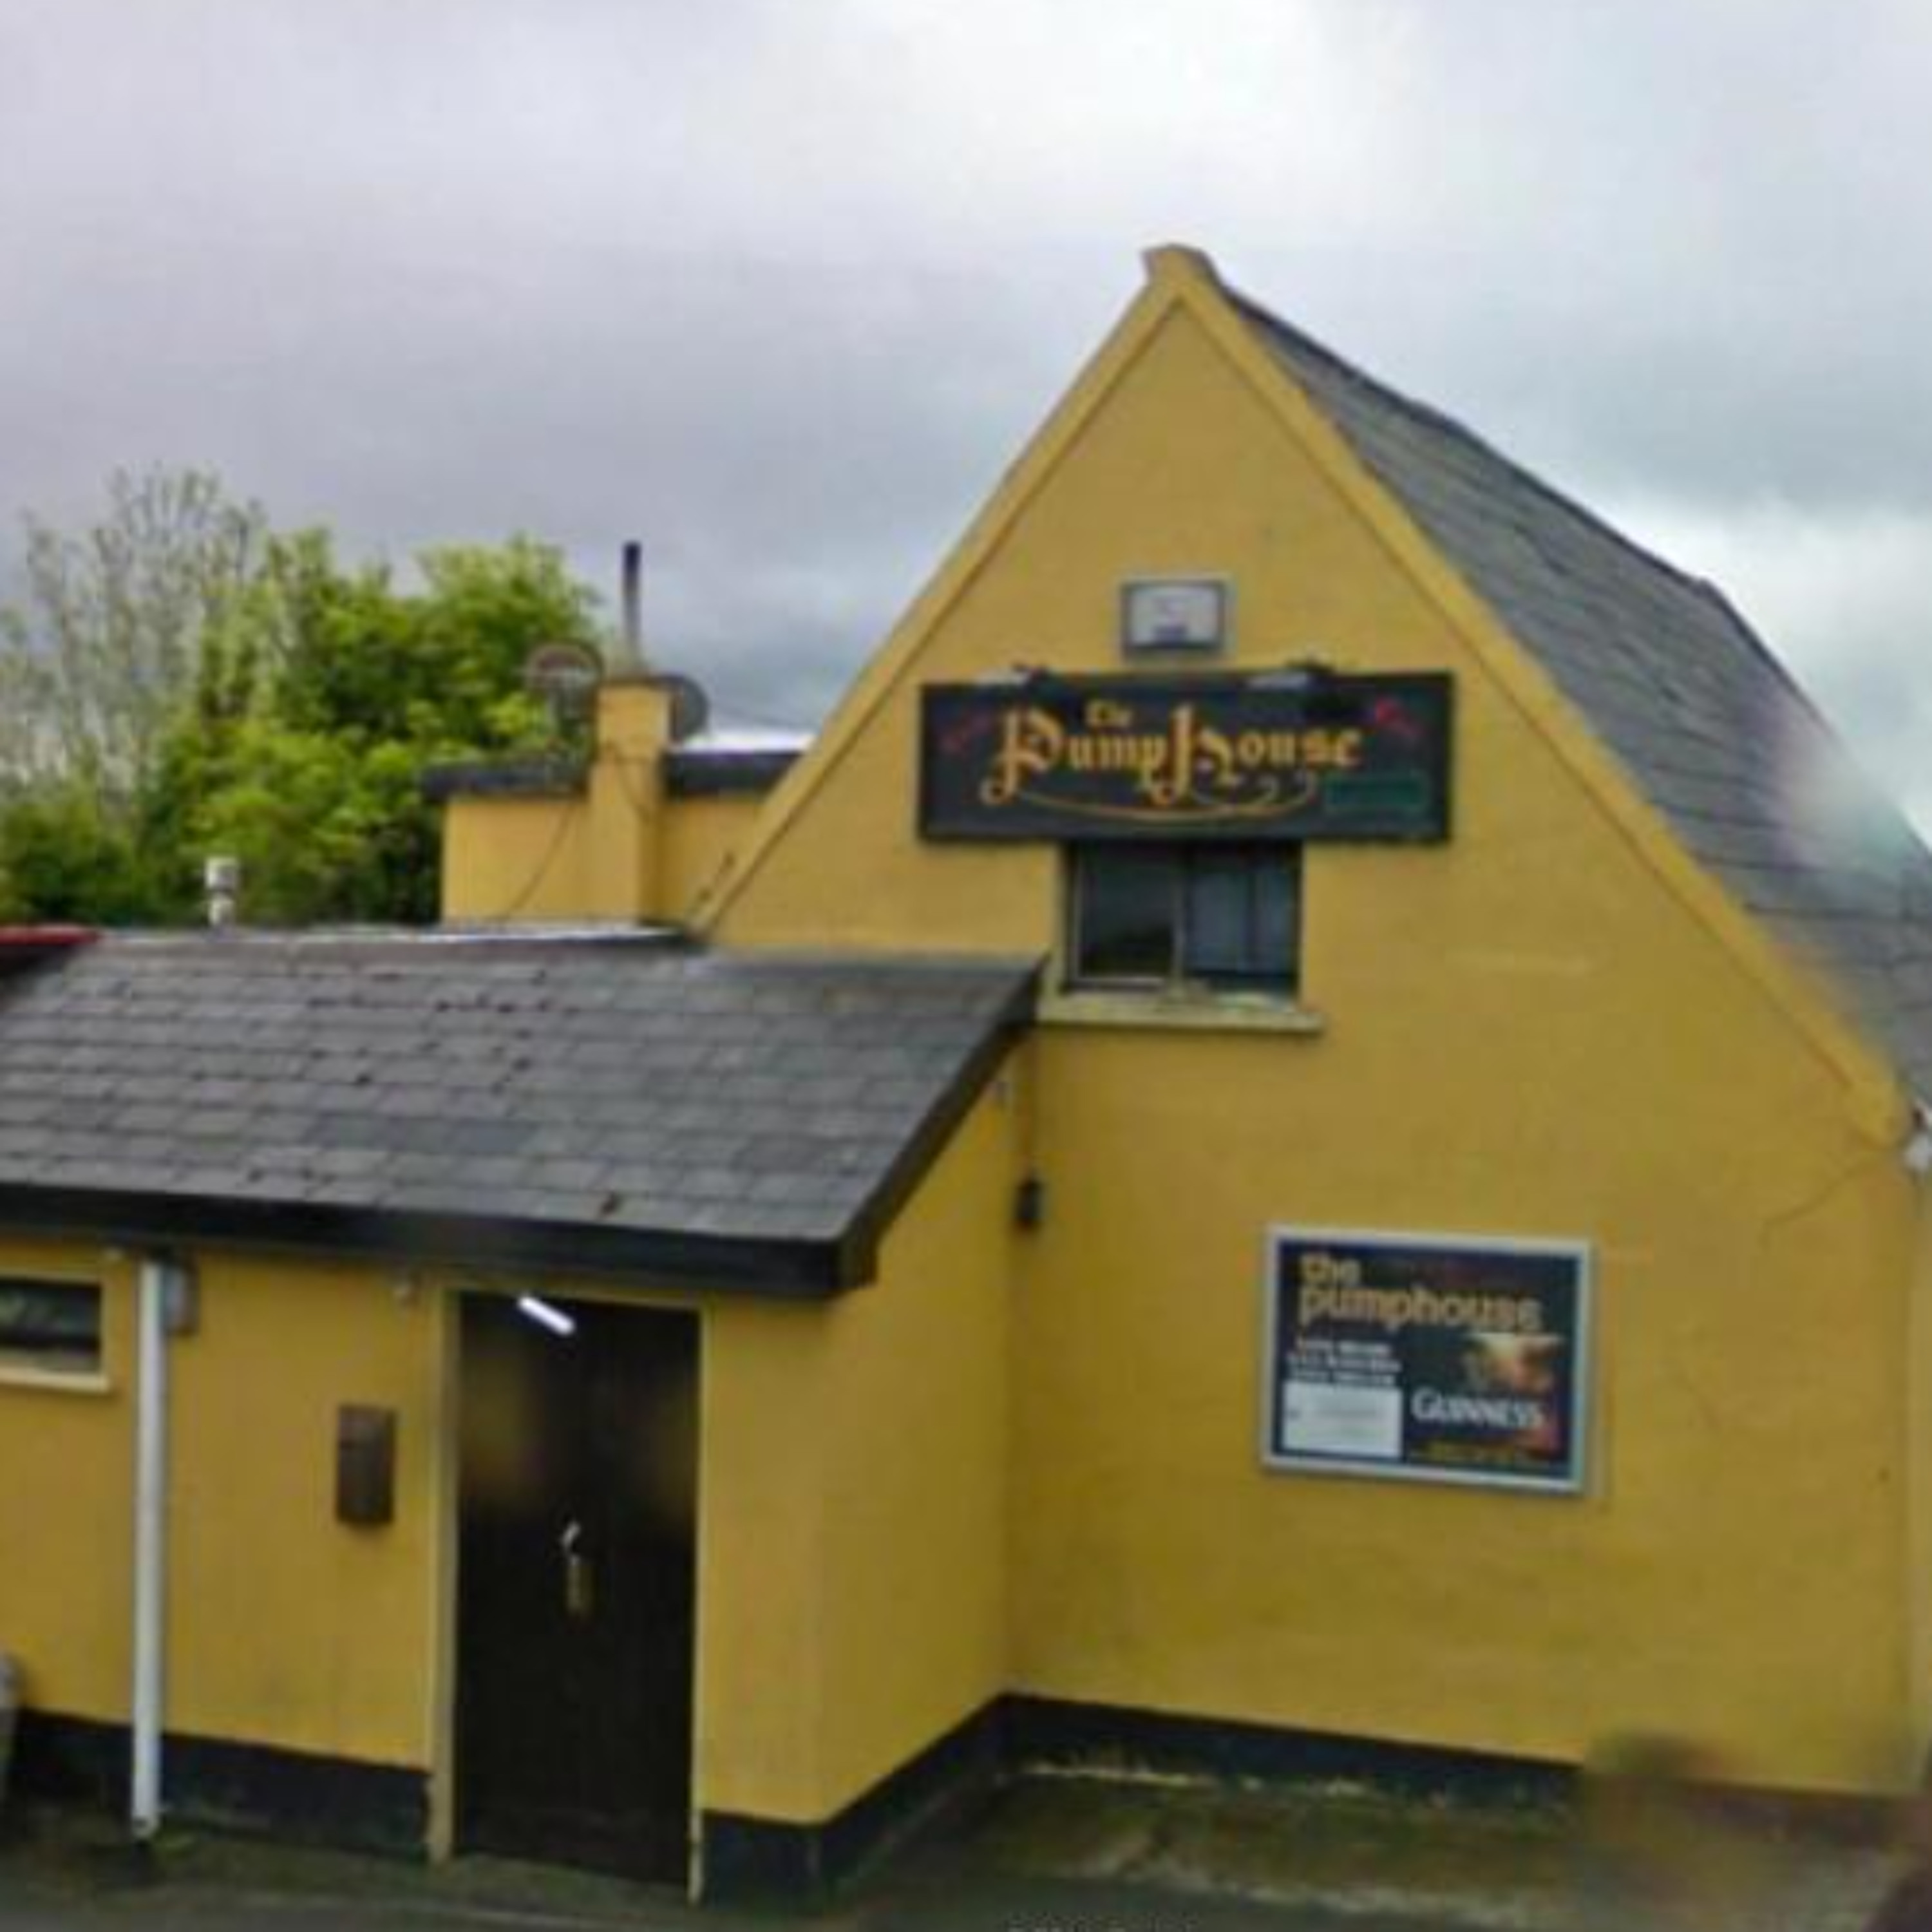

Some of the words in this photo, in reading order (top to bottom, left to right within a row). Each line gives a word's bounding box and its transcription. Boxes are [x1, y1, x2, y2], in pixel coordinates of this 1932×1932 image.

[1084, 699, 1135, 728] The
[1300, 1254, 1361, 1285] the
[1300, 1283, 1544, 1335] pumphouse
[1410, 1387, 1544, 1428] GUINNESS
